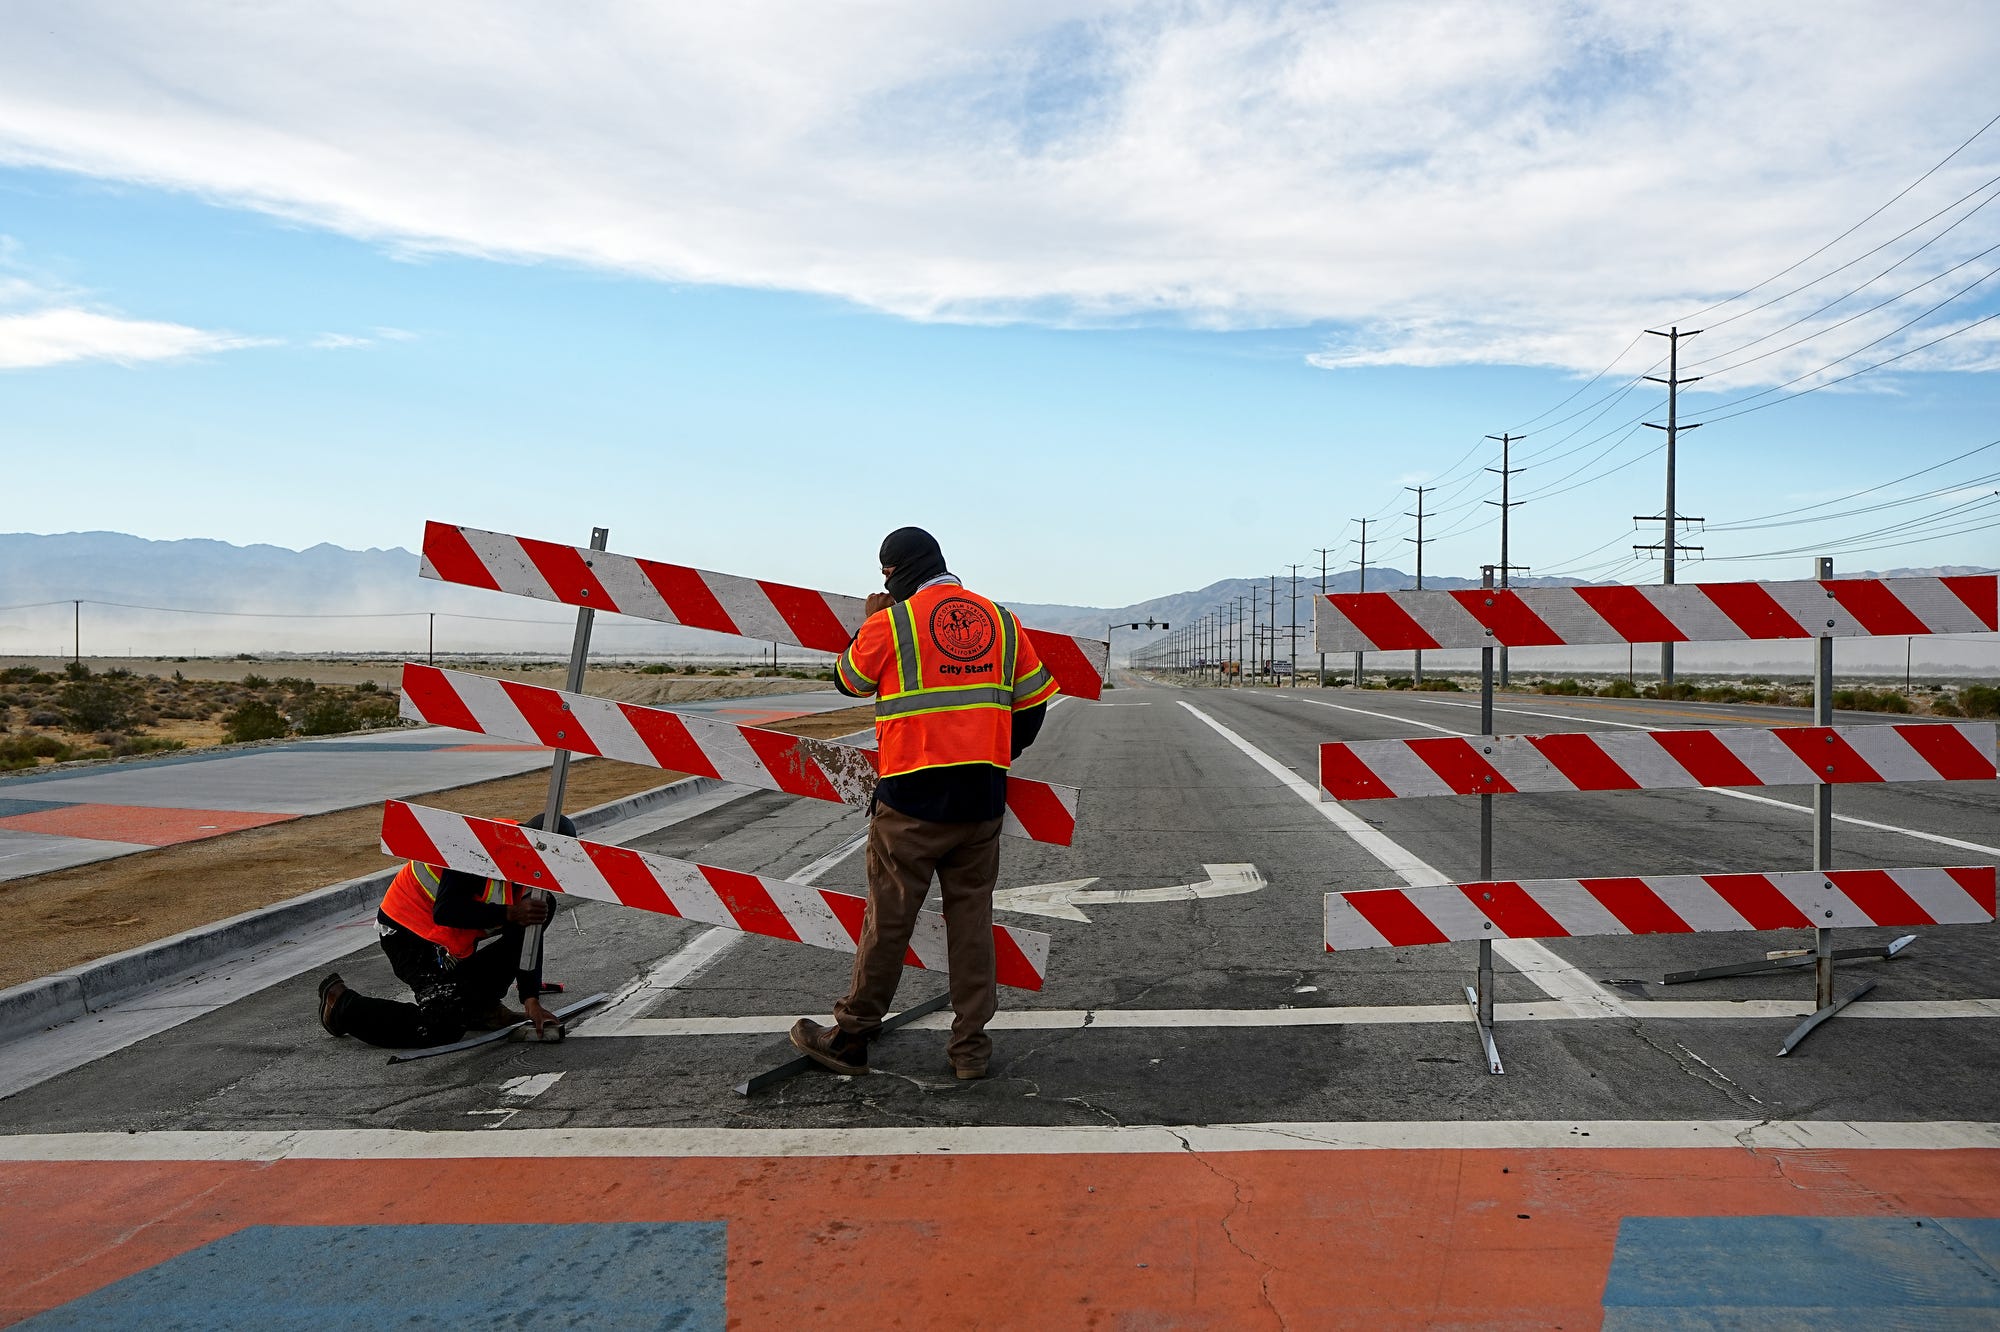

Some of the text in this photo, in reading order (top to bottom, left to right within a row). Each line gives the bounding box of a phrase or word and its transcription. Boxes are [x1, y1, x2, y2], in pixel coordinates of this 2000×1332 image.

[946, 645, 983, 655] CALIFORNIA
[940, 663, 993, 675] City Staff
